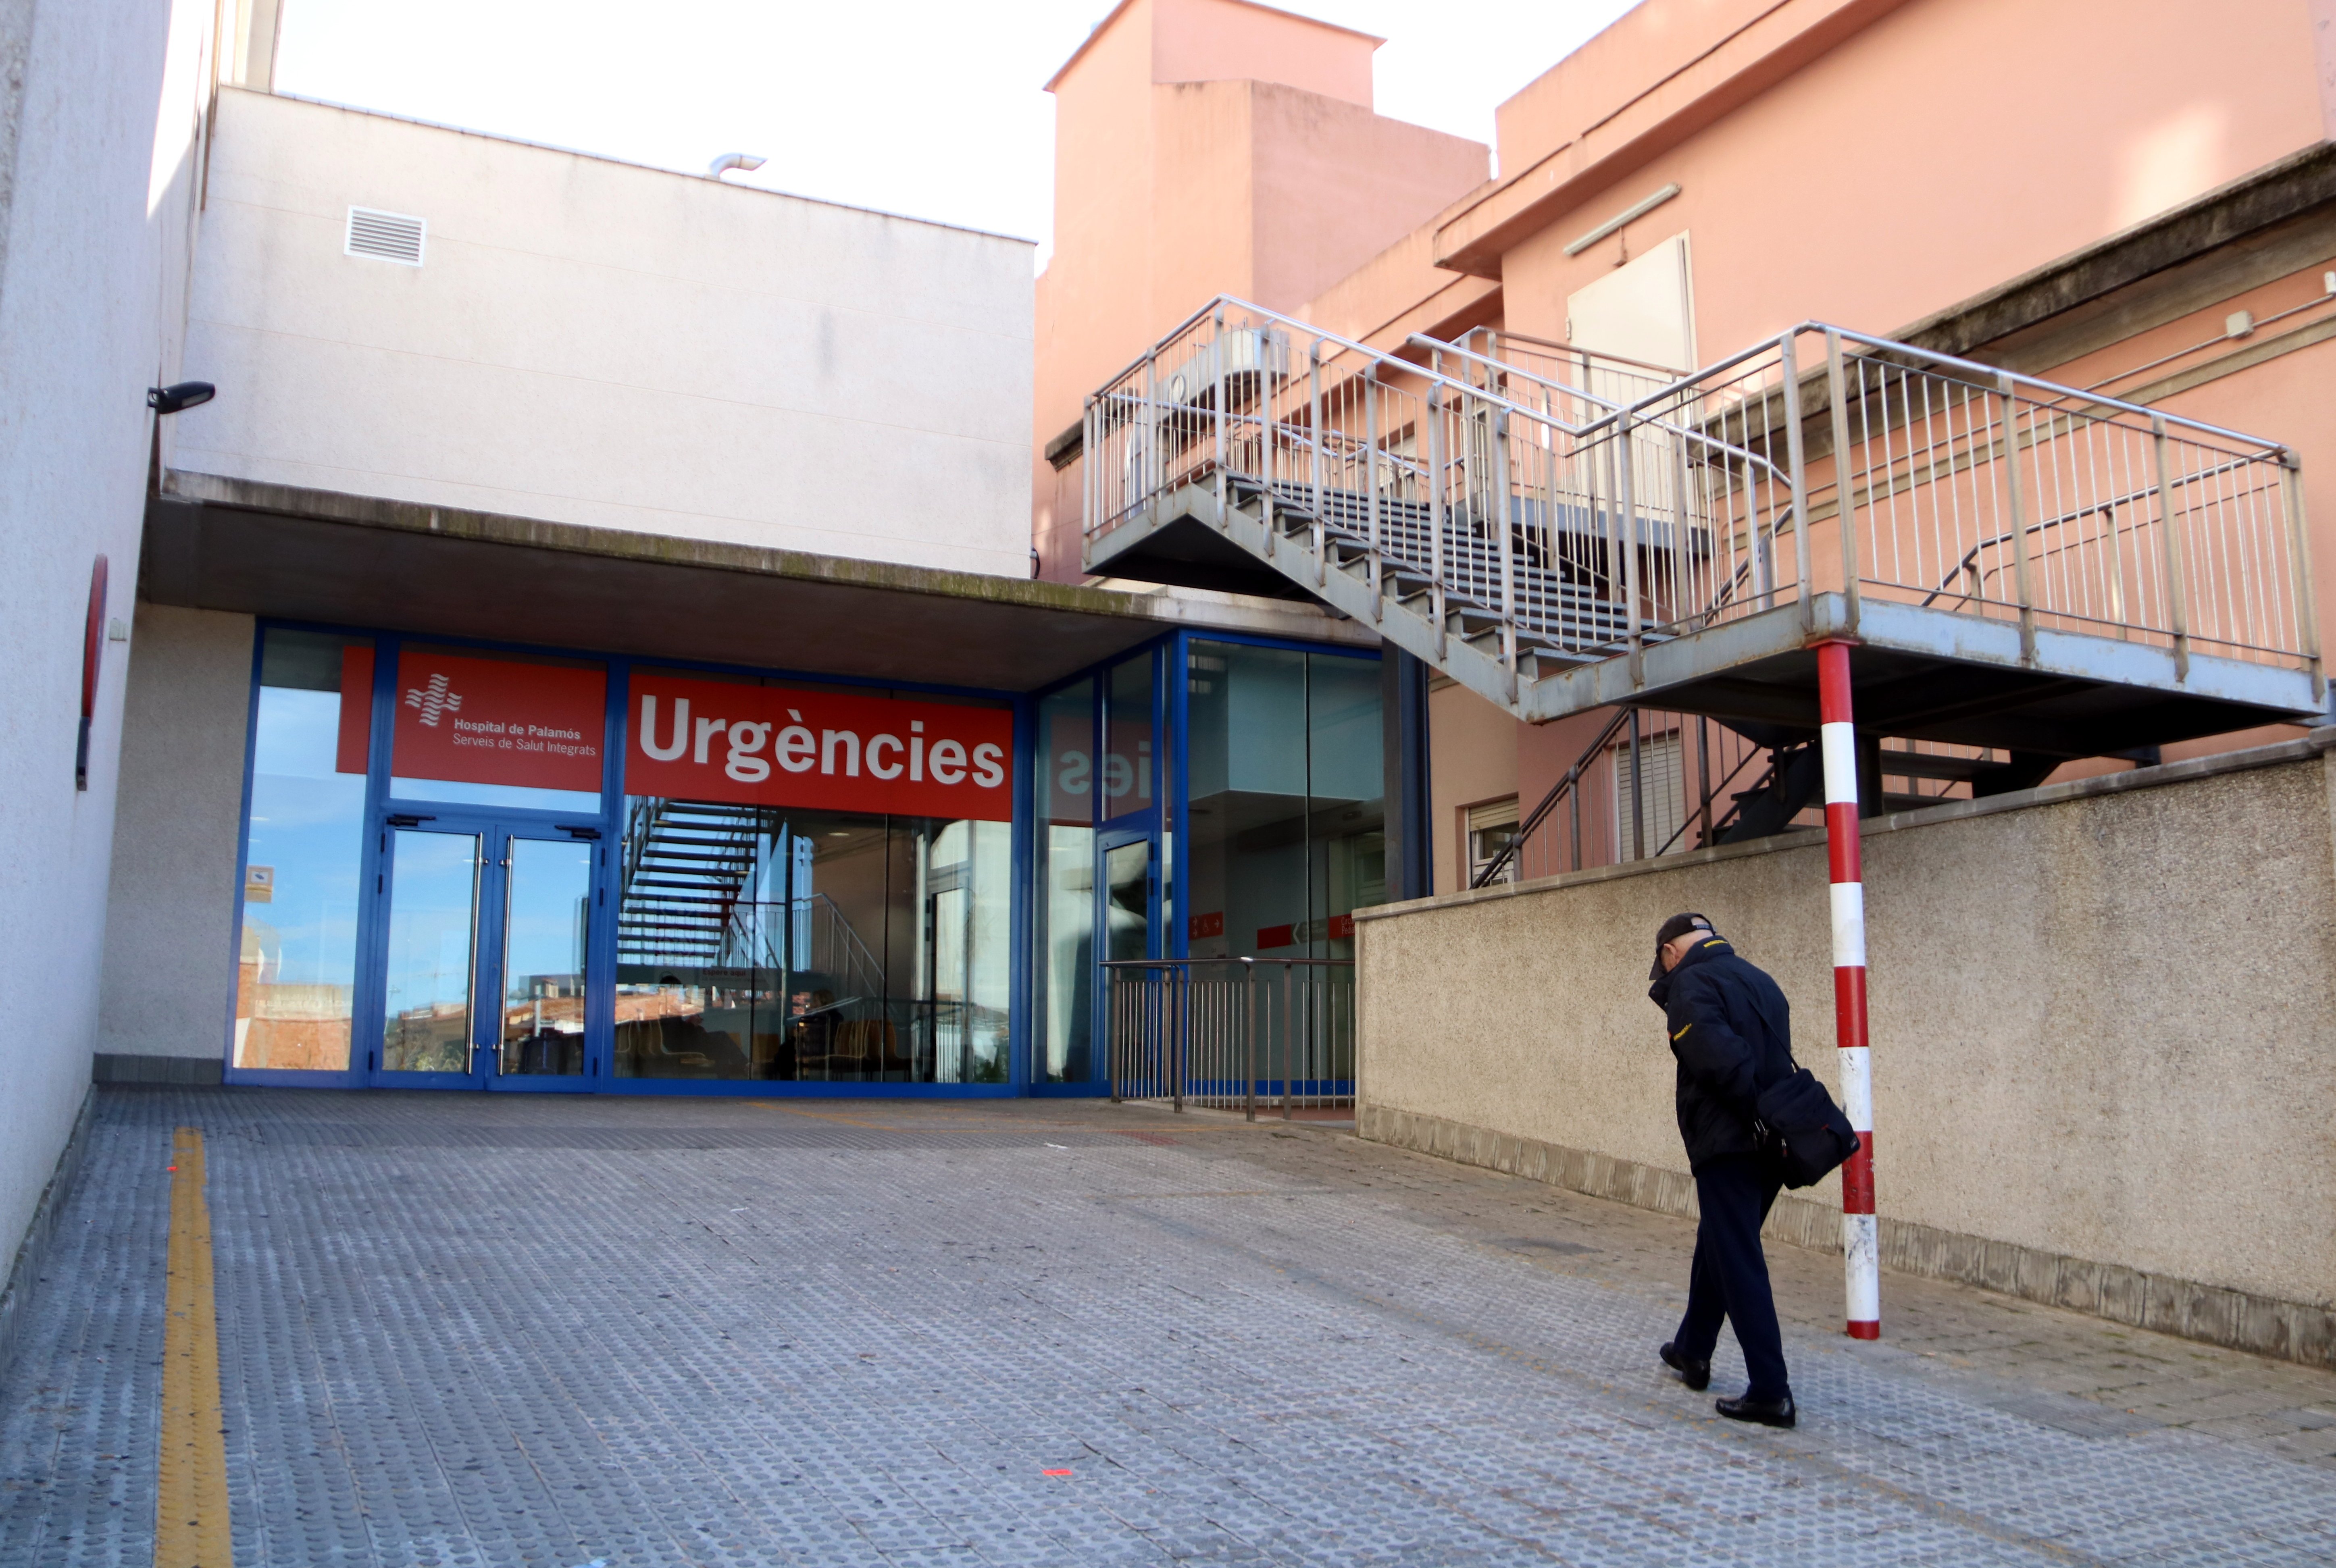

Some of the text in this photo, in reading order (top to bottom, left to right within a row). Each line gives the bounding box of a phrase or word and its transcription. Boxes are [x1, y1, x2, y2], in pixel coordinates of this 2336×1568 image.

[454, 718, 581, 739] Hospital de Palamós
[453, 733, 596, 756] Serveis de Salut Integrats
[640, 694, 1004, 788] Urgències
